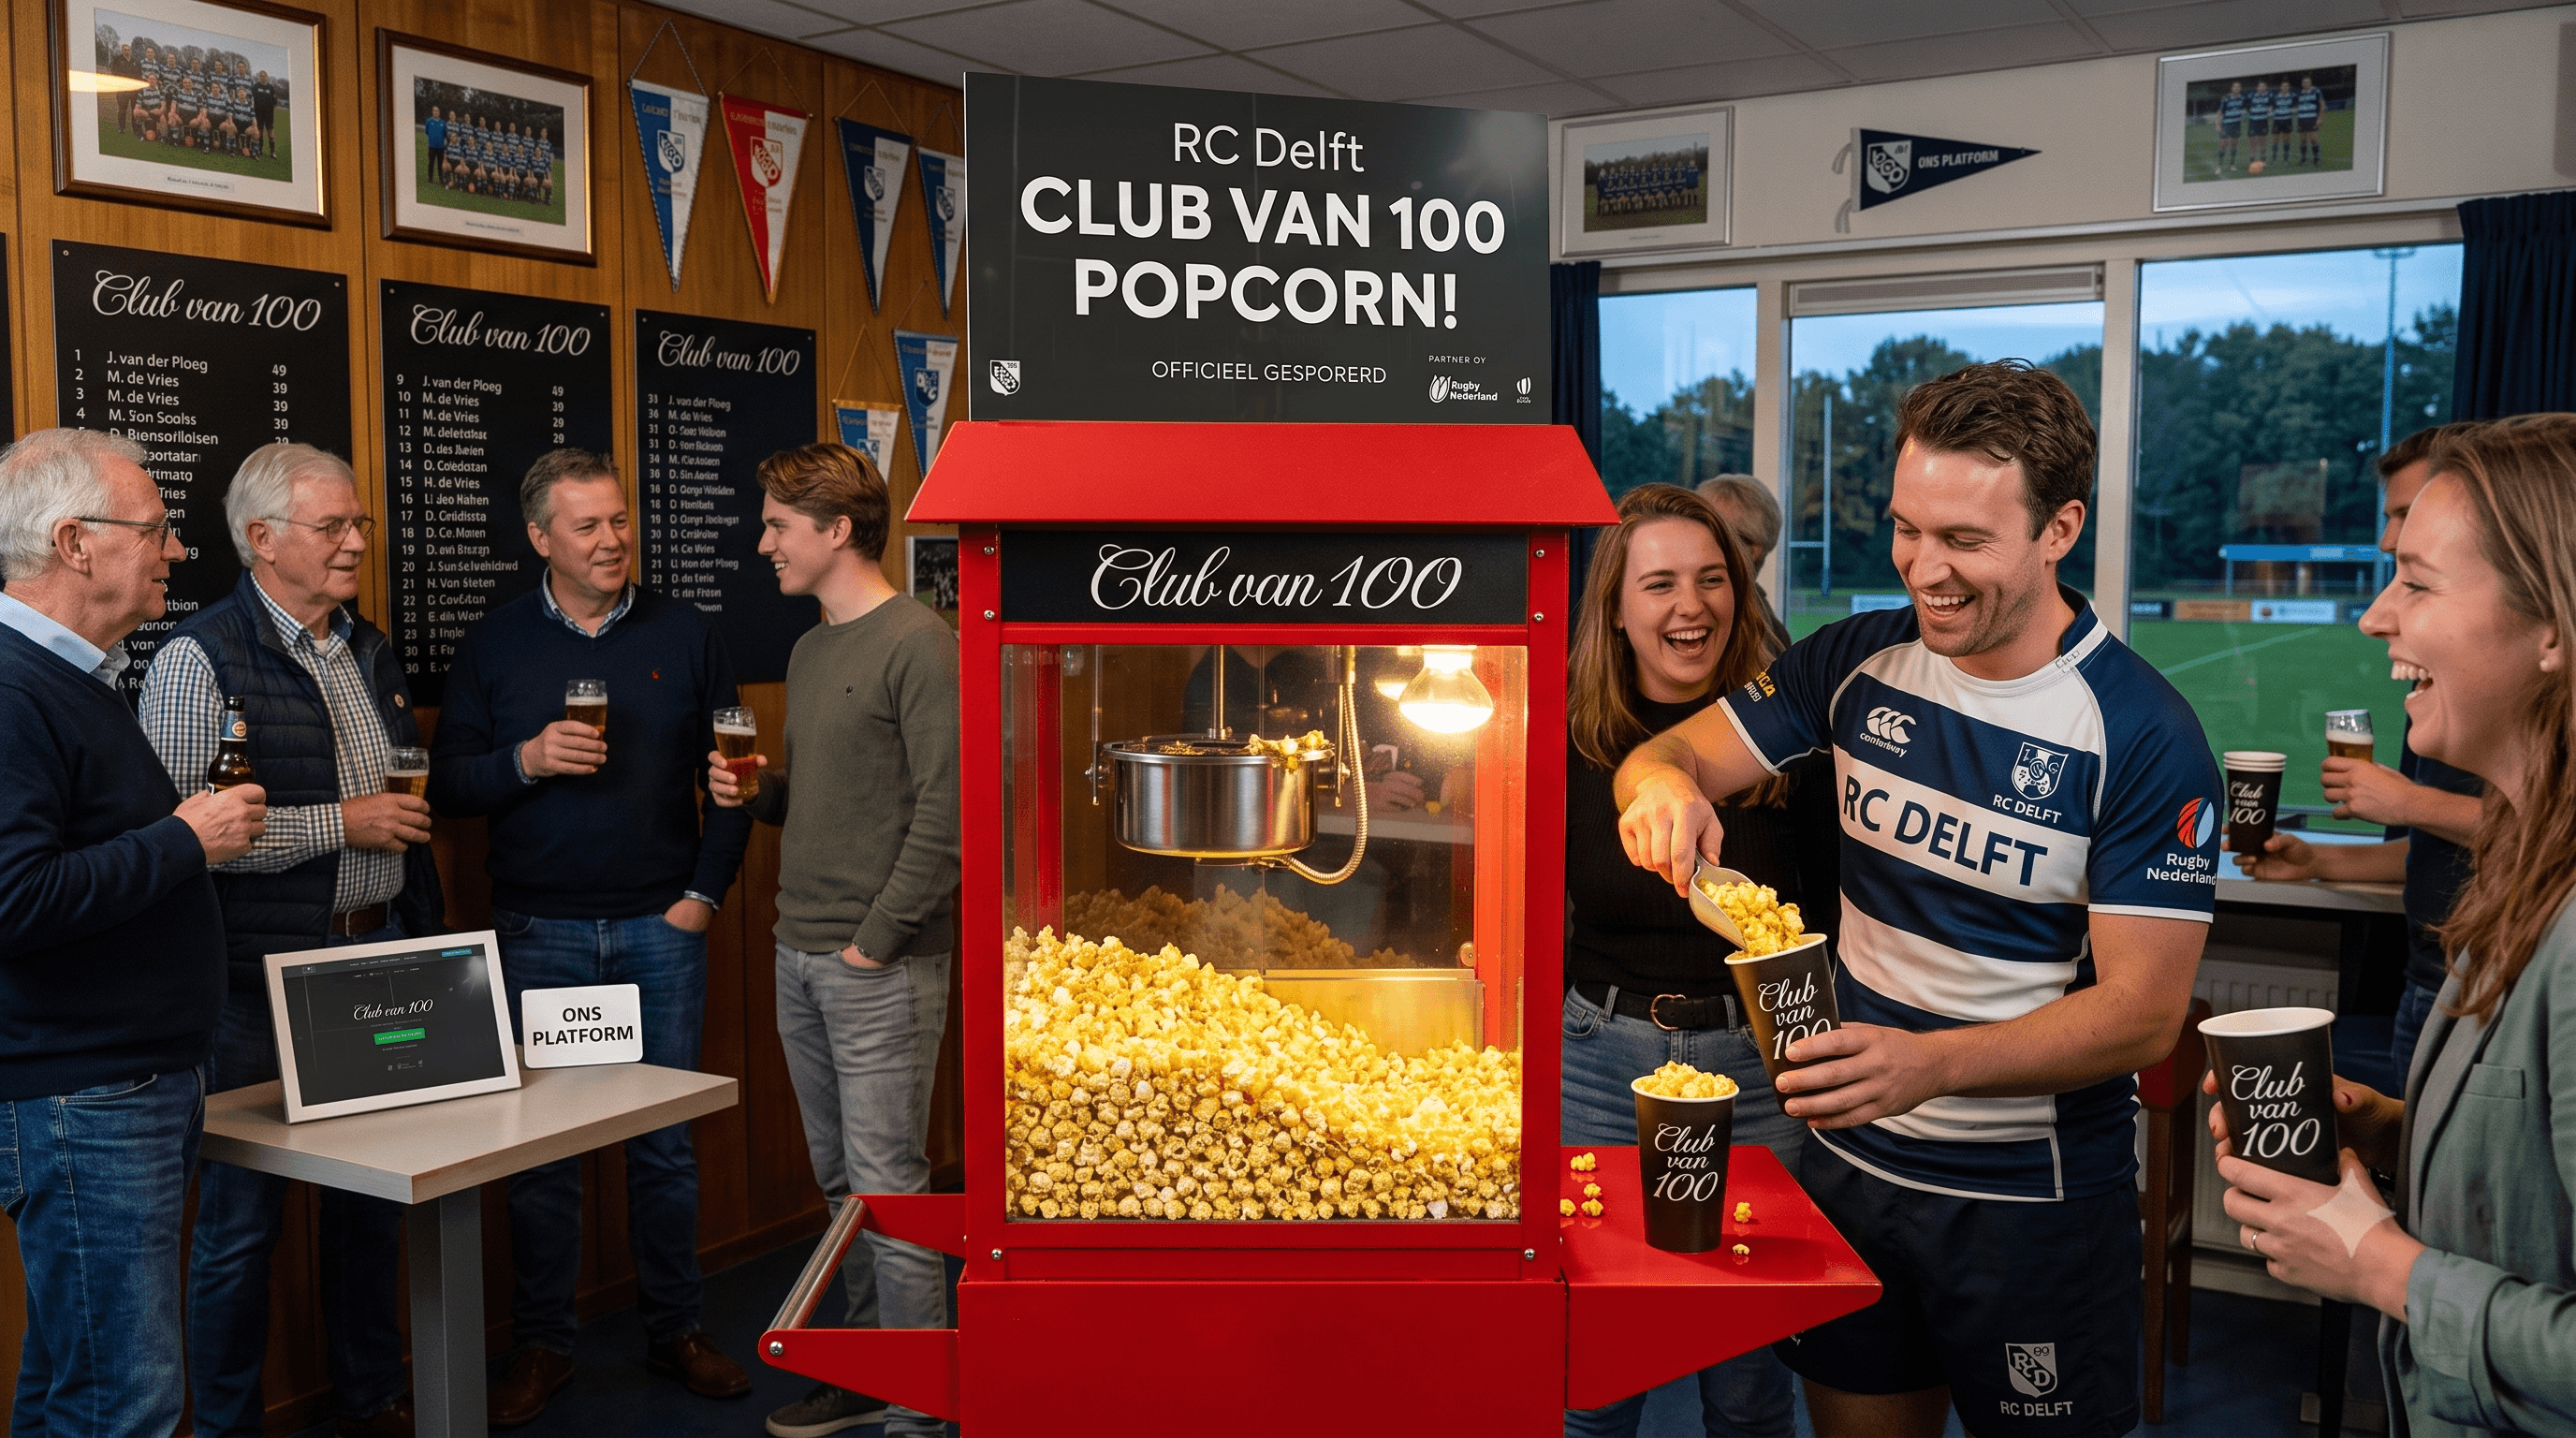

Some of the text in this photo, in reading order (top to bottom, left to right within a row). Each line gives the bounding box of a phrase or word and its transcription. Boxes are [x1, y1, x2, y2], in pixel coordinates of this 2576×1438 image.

[1174, 123, 1366, 173] RC Delft
[1918, 155, 1939, 169] ONS
[1941, 149, 1999, 167] PLATFORM
[1020, 175, 1505, 255] CLUB VAN 100
[93, 270, 321, 331] Club van 100
[1075, 257, 1458, 330] POPCORN!
[410, 303, 591, 357] Club van 100
[74, 348, 286, 376] 1 J. van der Ploeg 49
[657, 330, 800, 375] Club van 100
[1428, 355, 1471, 364] PARTNER
[75, 368, 287, 394] 2 M. de Vries 39
[1152, 360, 1386, 384] OFFICIEEL GESPORERD
[396, 374, 404, 385] 9
[422, 375, 431, 387] J.
[432, 378, 452, 389] van
[453, 377, 472, 390] der
[473, 379, 502, 395] Ploeg
[1451, 380, 1481, 392] Rugby
[76, 388, 288, 413] 3 M. de Vries 39
[398, 390, 564, 413] 10 M. de Vries 39
[693, 397, 707, 408] der
[1449, 391, 1499, 402] Nederland
[76, 407, 86, 419] 4
[109, 408, 126, 421] M.
[398, 407, 564, 428] 11 M. de Vries 29
[399, 425, 564, 444] 12 M. 29
[399, 442, 412, 453] 13
[423, 442, 435, 455] D.
[436, 443, 453, 455] des
[400, 459, 413, 470] 14
[400, 476, 480, 489] 15 H. de Vries
[400, 493, 413, 505] 16
[401, 510, 436, 521] 17 D.
[401, 527, 415, 538] 18
[425, 527, 437, 538] D.
[402, 544, 438, 556] 19 D.
[402, 561, 457, 572] 20 J. Sun
[402, 579, 415, 589] 21
[1090, 543, 1463, 610] Club van 100
[402, 595, 416, 606] 22
[403, 612, 417, 623] 22
[404, 629, 417, 639] 23
[404, 646, 418, 656] 30
[405, 663, 419, 674] 30
[1992, 794, 2062, 824] RC DELFT
[2230, 807, 2266, 825] 100
[1843, 773, 2049, 887] RC DELFT
[2166, 853, 2210, 870] Rugby
[2146, 867, 2217, 886] Nederland
[1758, 972, 1818, 1012] Club
[353, 999, 433, 1020] Club 100
[562, 1006, 602, 1022] ONS
[1776, 1005, 1815, 1027] van
[533, 1025, 634, 1047] PLATFORM
[2231, 1061, 2306, 1101] Club
[2248, 1100, 2302, 1120] van
[1654, 1123, 1717, 1154] Club
[2242, 1118, 2321, 1159] 100
[1667, 1154, 1709, 1170] van
[1653, 1171, 1719, 1202] 100
[1999, 1401, 2073, 1416] RC DELFT
